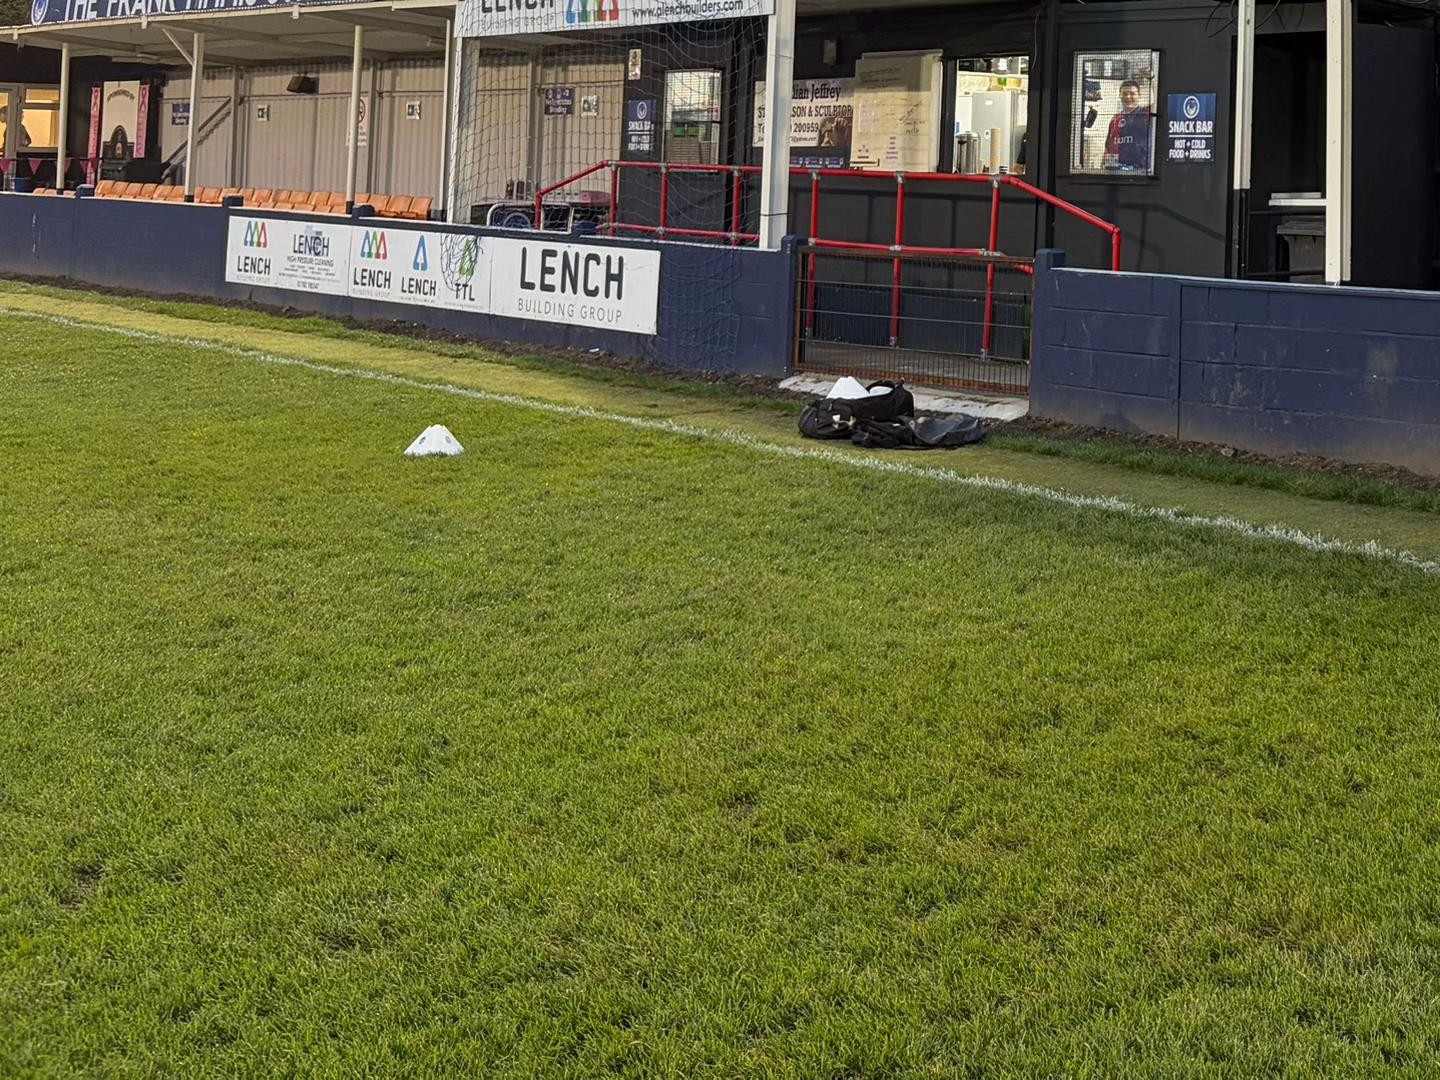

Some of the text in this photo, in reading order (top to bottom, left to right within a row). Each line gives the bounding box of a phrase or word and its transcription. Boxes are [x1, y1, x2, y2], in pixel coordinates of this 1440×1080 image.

[811, 83, 841, 101] Jeffrey
[808, 105, 813, 117] &
[814, 104, 854, 118] SCULPTOR
[1168, 120, 1214, 134] SNACK BAR
[1174, 139, 1186, 149] HOT
[1191, 139, 1206, 149] COLD
[1168, 149, 1184, 159] FOOD
[1190, 149, 1211, 159] DRINKS
[292, 234, 330, 257] LENCH
[237, 255, 271, 275] LENCH
[520, 246, 624, 300] LENCH
[353, 267, 392, 289] LENCH
[401, 276, 437, 296] LENCH
[454, 283, 476, 301] TTL
[518, 297, 622, 323] BUILDING GROUP
